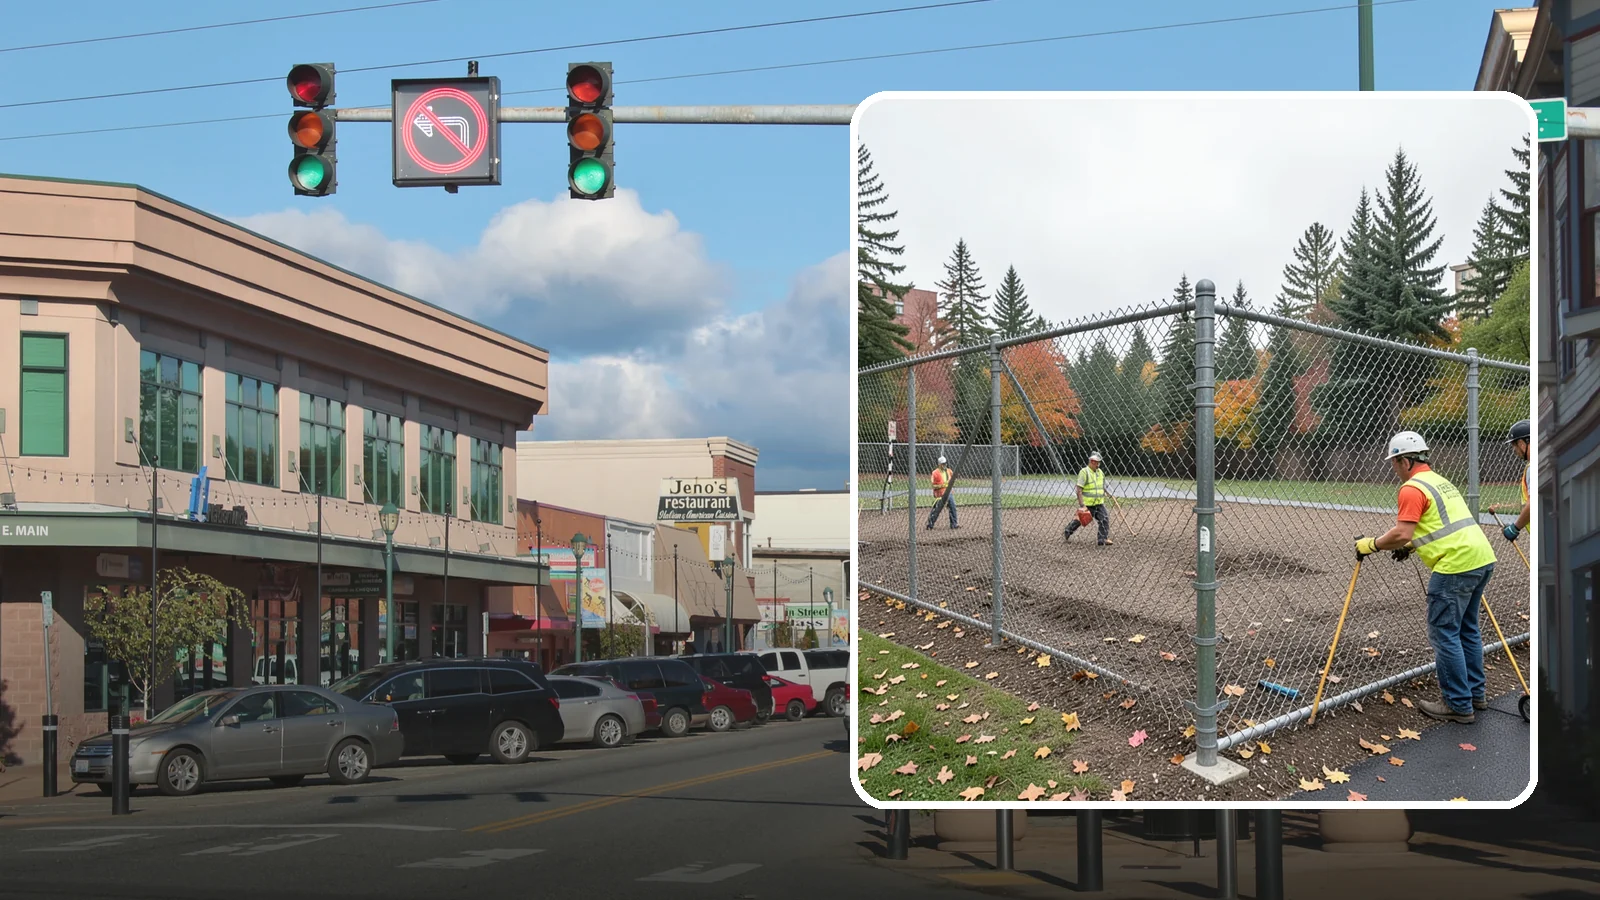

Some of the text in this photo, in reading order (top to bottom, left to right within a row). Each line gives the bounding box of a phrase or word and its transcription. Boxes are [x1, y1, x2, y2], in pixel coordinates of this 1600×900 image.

[669, 480, 728, 495] Jeno's
[665, 497, 731, 509] restaurant
[658, 510, 681, 520] Italian
[685, 510, 715, 520] American
[715, 510, 738, 519] Cuisine
[2, 525, 49, 536] E. MAIN
[797, 607, 828, 617] Street
